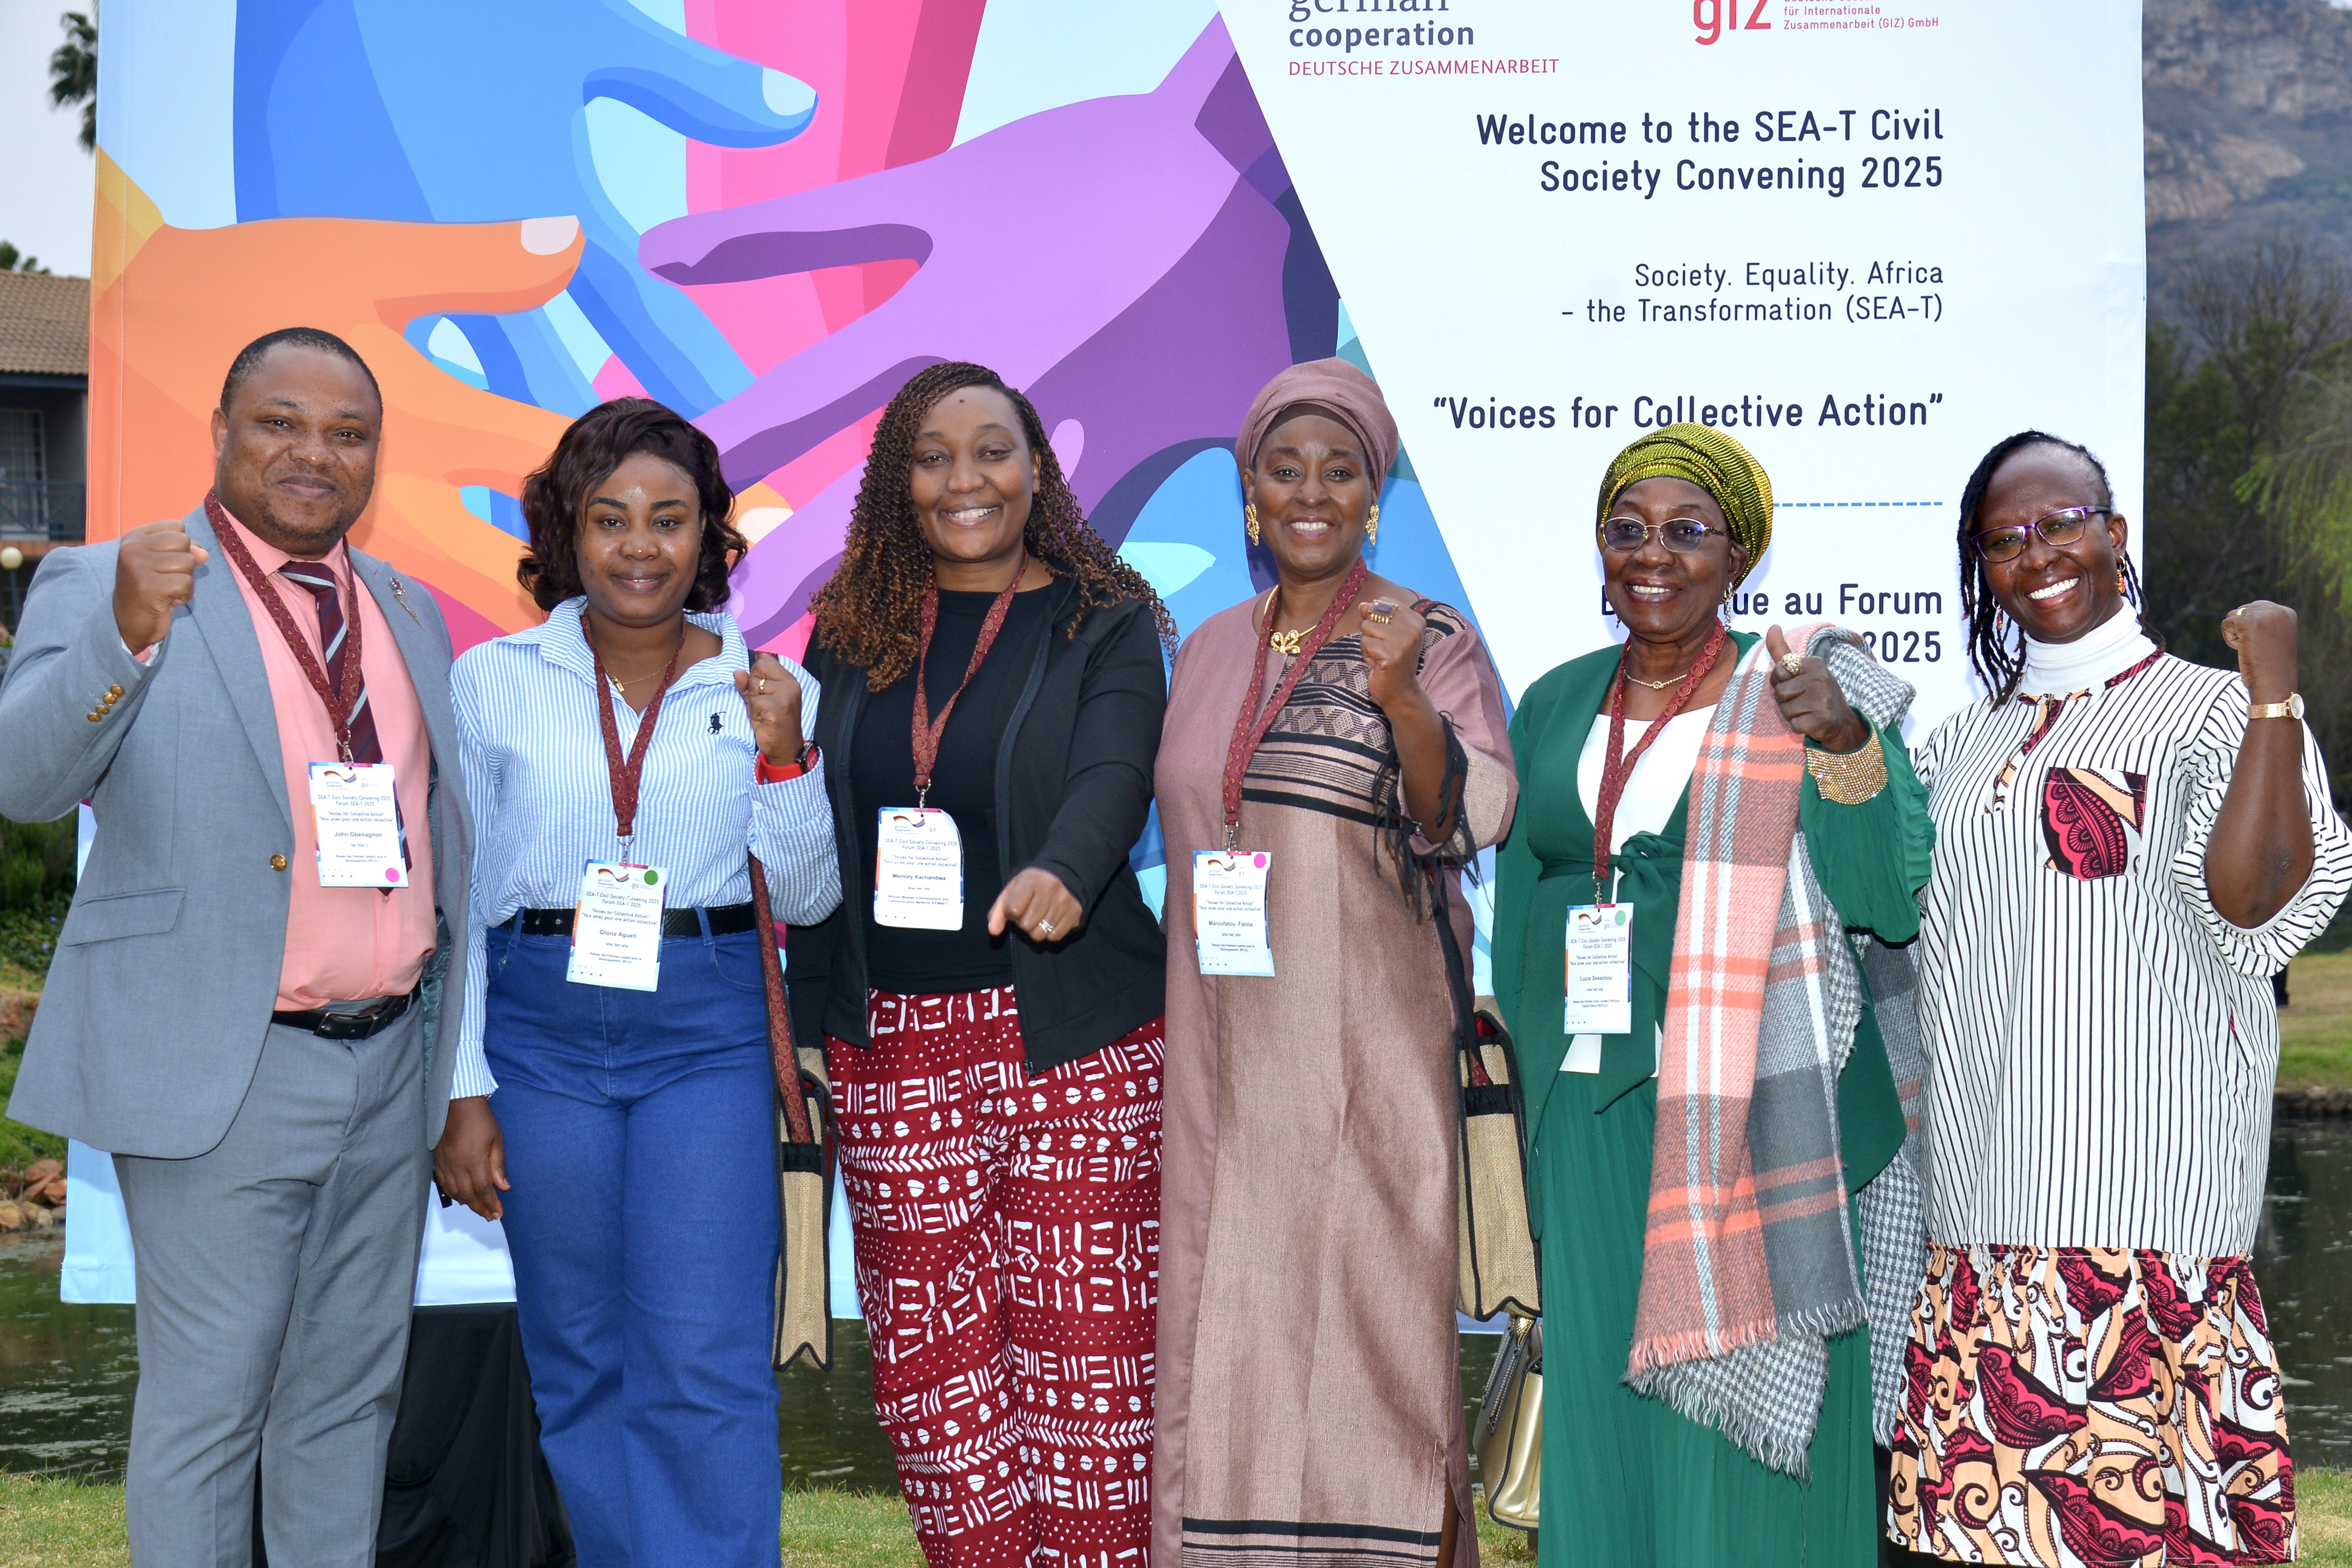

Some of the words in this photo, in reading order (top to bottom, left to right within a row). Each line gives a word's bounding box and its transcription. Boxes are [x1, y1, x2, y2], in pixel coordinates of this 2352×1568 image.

[1784, 6, 1800, 16] für
[1805, 5, 1881, 15] Internationale
[1784, 19, 1874, 30] Zusammenarbeit
[1879, 17, 1905, 29] (GIZ)
[1908, 17, 1939, 27] GmbH
[1290, 20, 1473, 53] cooperation
[1290, 61, 1383, 76] DEUTSCHE
[1389, 59, 1560, 75] ZUSAMMENARBEIT
[1477, 114, 1626, 145] Welcome
[1642, 113, 1672, 143] to
[1688, 112, 1739, 143] the
[1755, 110, 1856, 142] SEA-T
[1872, 108, 1943, 140] Civil
[1541, 160, 1661, 200] Society
[1677, 158, 1844, 198] Convening
[1862, 156, 1942, 187] 2025
[1635, 263, 1731, 292] Society.
[1746, 262, 1854, 291] Equality.
[1867, 261, 1944, 284] Africa
[1586, 298, 1626, 322] the
[1638, 297, 1831, 322] Transformation
[1846, 293, 1942, 323] (SEA-T)
[1434, 396, 1555, 429] “Voices
[1571, 396, 1618, 428] for
[1634, 395, 1803, 428] Collective
[1818, 393, 1943, 427] Action”
[1784, 593, 1822, 615] au
[1840, 583, 1942, 615] Forum
